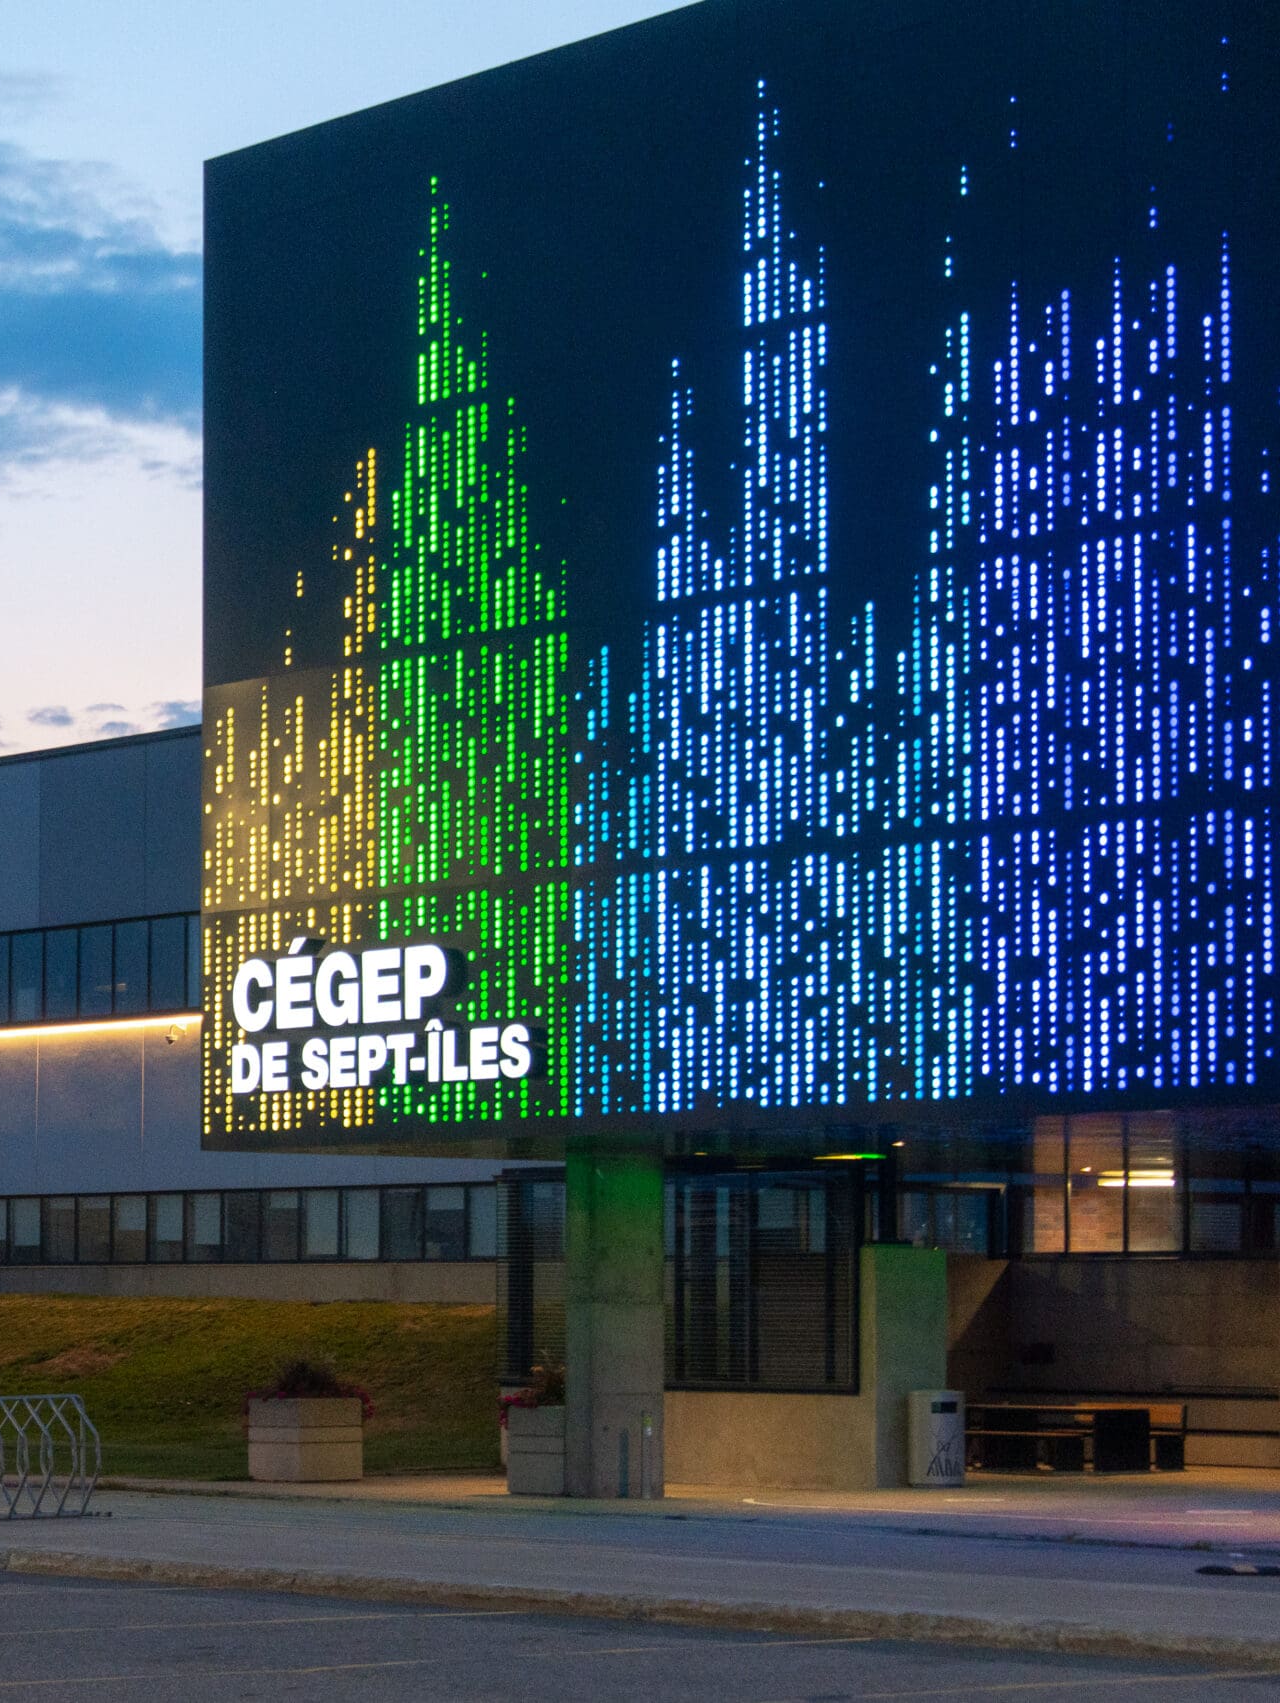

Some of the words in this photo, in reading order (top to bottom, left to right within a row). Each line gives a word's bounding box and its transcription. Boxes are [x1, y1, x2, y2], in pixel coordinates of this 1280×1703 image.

[233, 937, 447, 1032] CÉGEP
[231, 1041, 289, 1093] DE
[301, 1018, 531, 1090] SEPT-ÎLES
